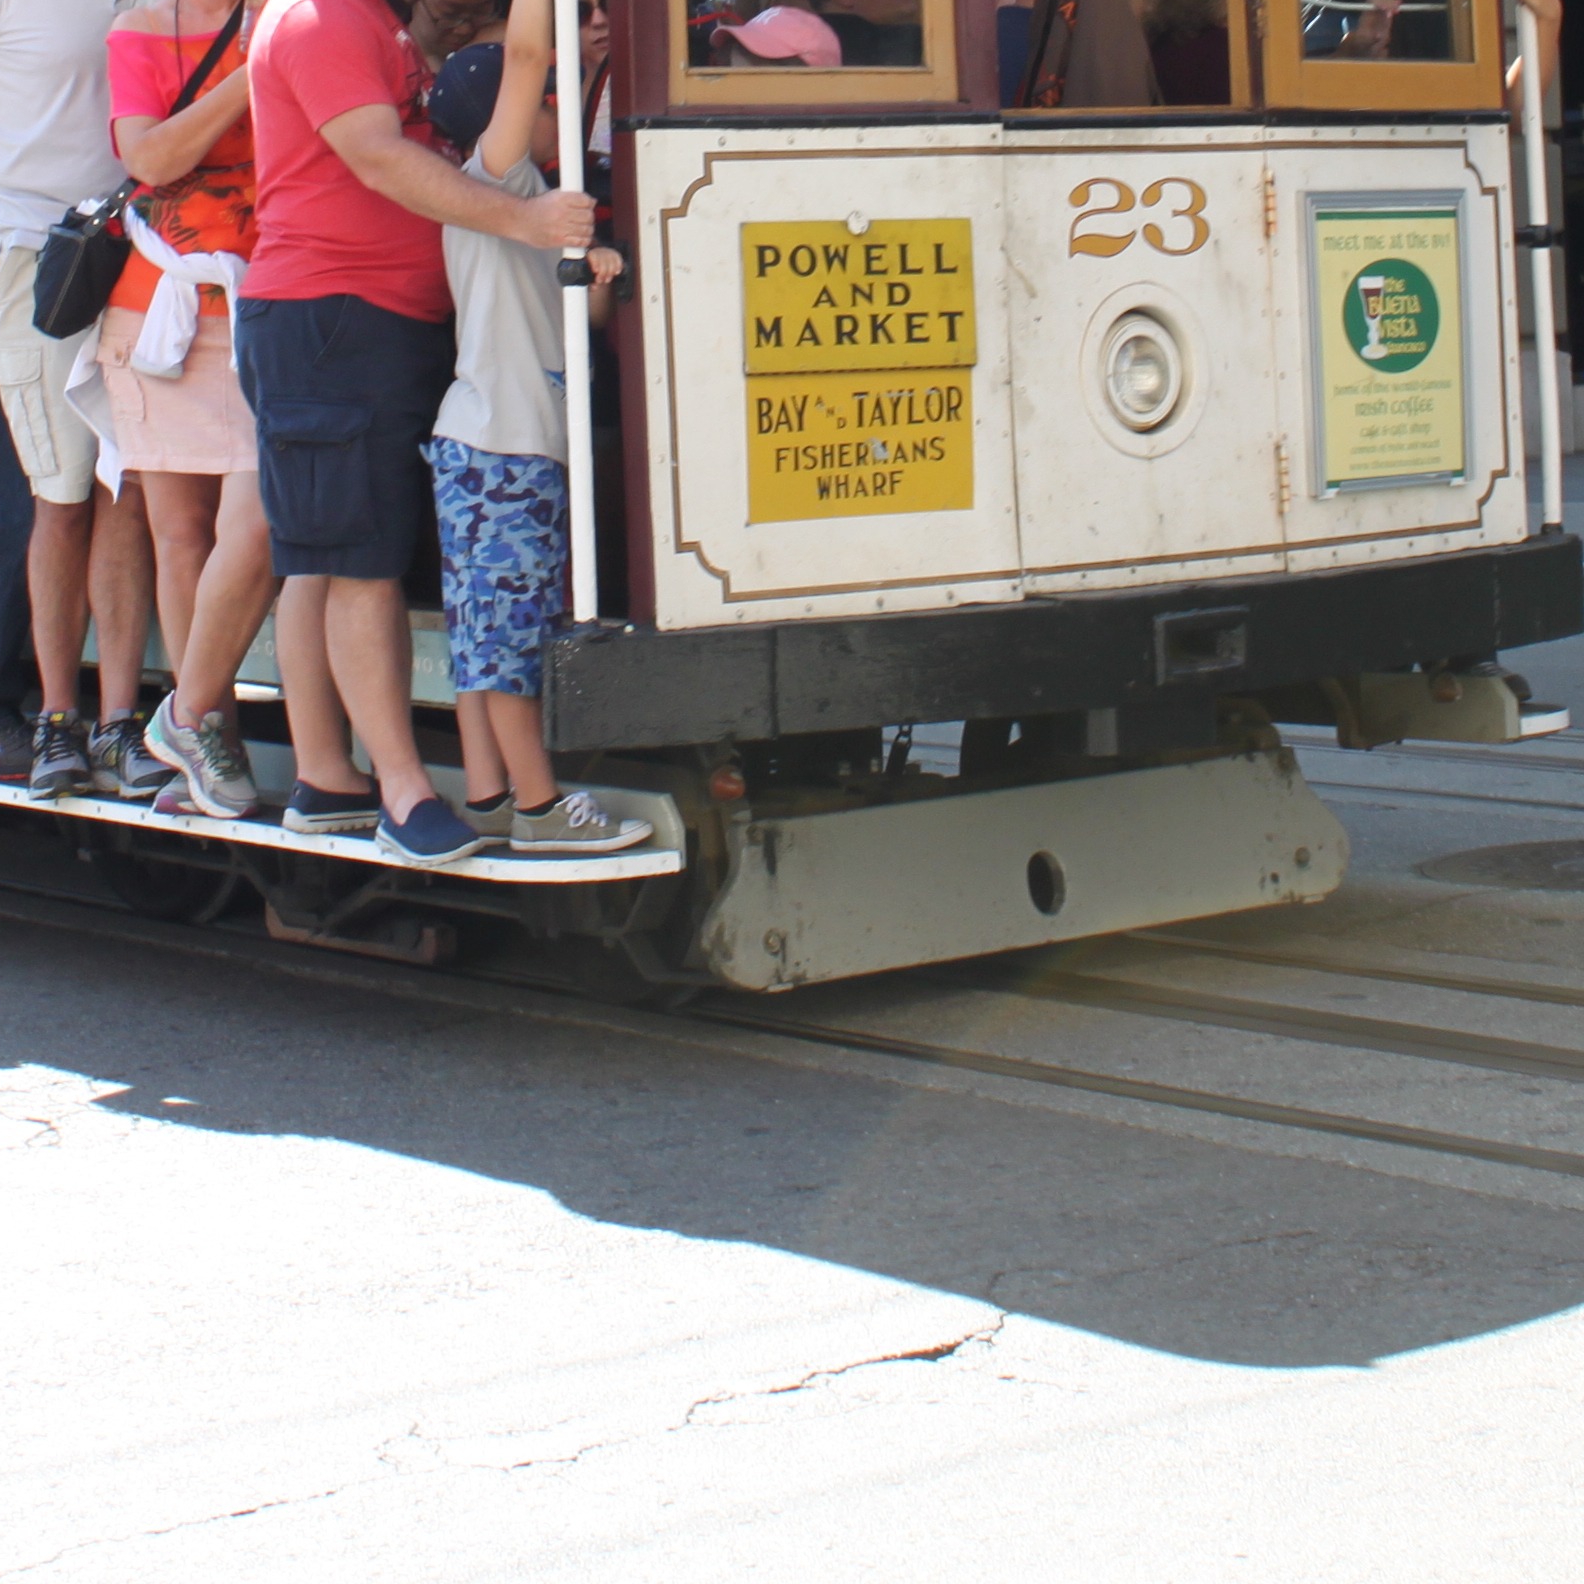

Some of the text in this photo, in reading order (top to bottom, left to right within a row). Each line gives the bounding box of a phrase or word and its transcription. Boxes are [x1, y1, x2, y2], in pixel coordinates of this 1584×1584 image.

[1068, 176, 1210, 258] 23
[754, 242, 959, 278] POWELL
[811, 282, 912, 309] AND
[754, 310, 965, 349] MARKET
[756, 385, 964, 435] BAY AND TAYLOR
[815, 469, 904, 501] WHARF
